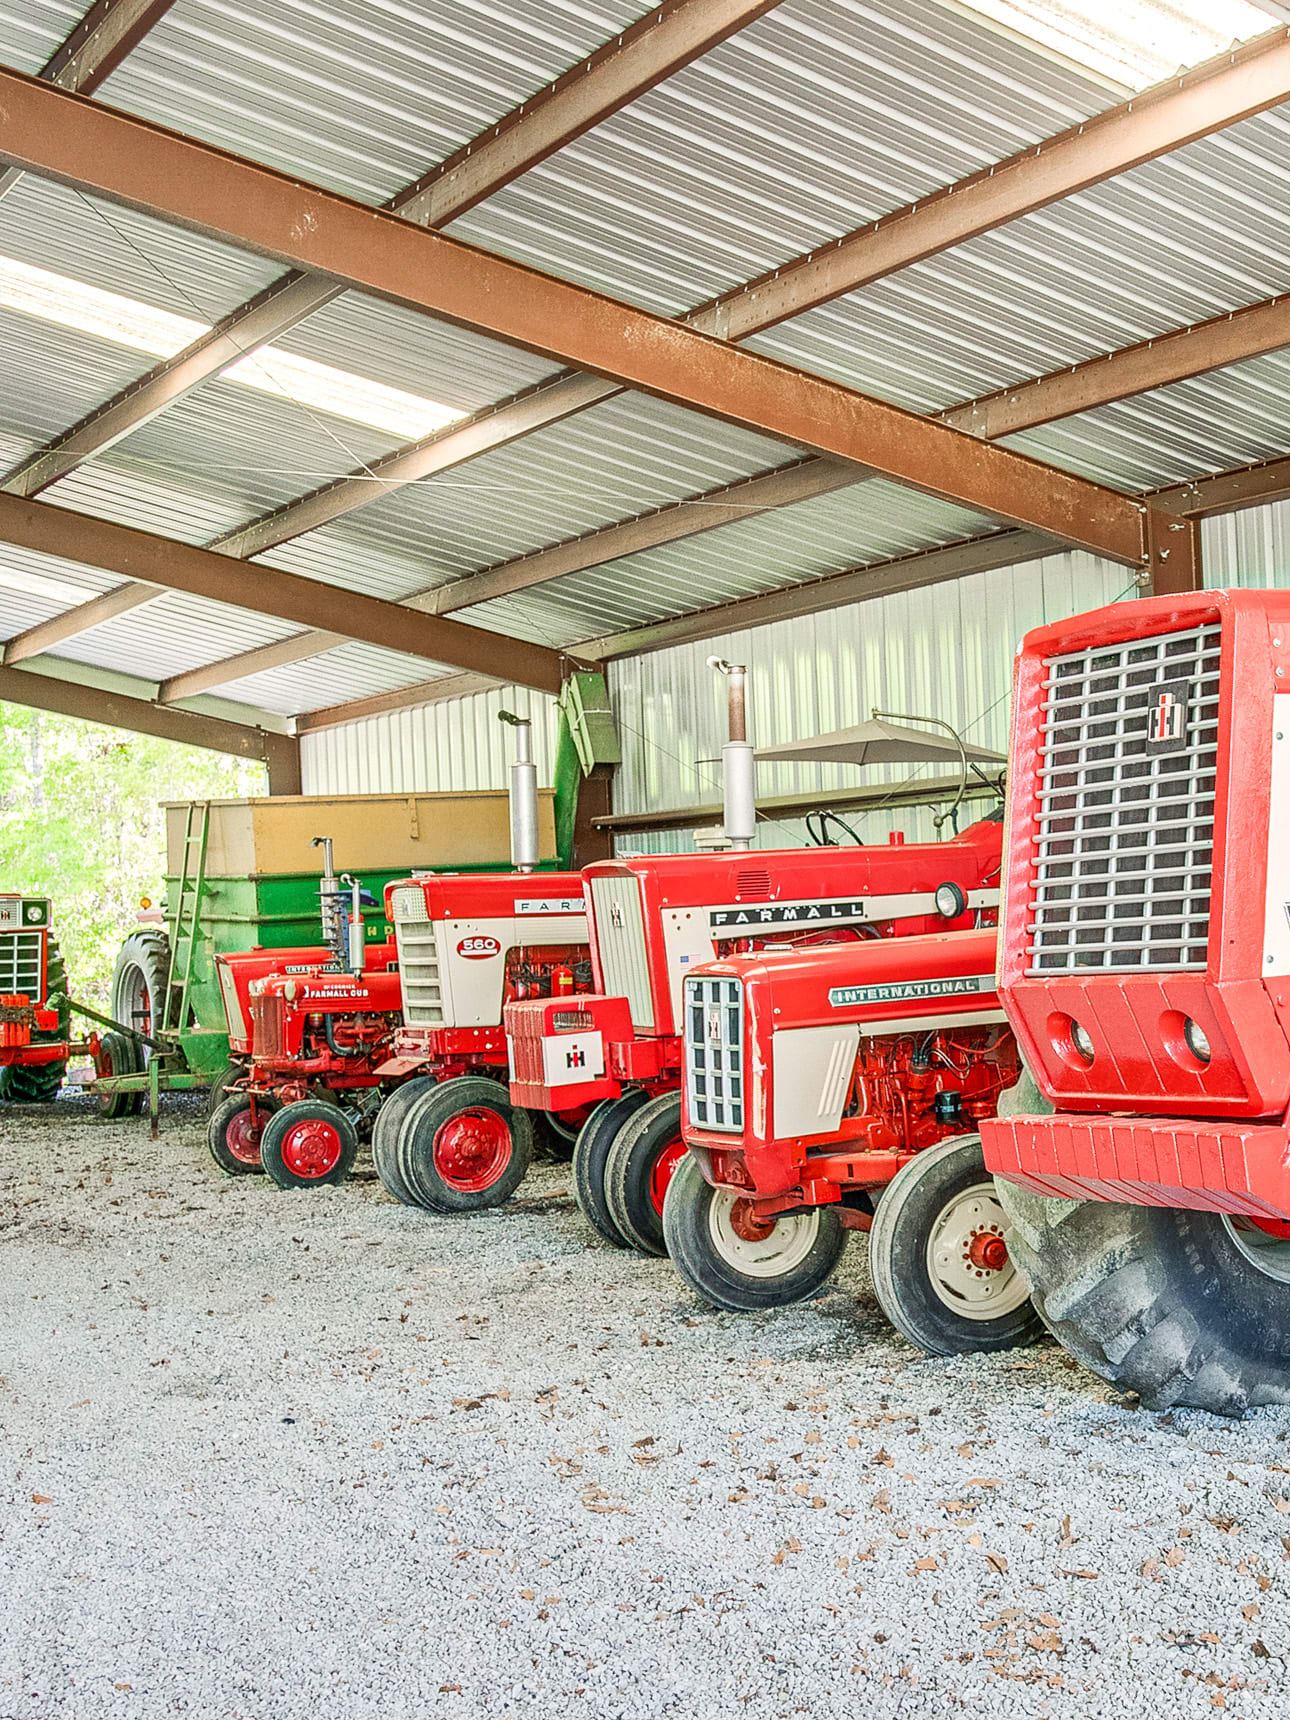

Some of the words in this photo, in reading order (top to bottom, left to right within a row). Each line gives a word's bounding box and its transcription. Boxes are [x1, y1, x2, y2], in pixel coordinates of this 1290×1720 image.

[714, 903, 862, 926] FARMALL
[463, 938, 496, 950] 560
[310, 990, 348, 998] FARMALL
[350, 989, 369, 997] CUB
[837, 981, 976, 1003] INTERNATIONAL
